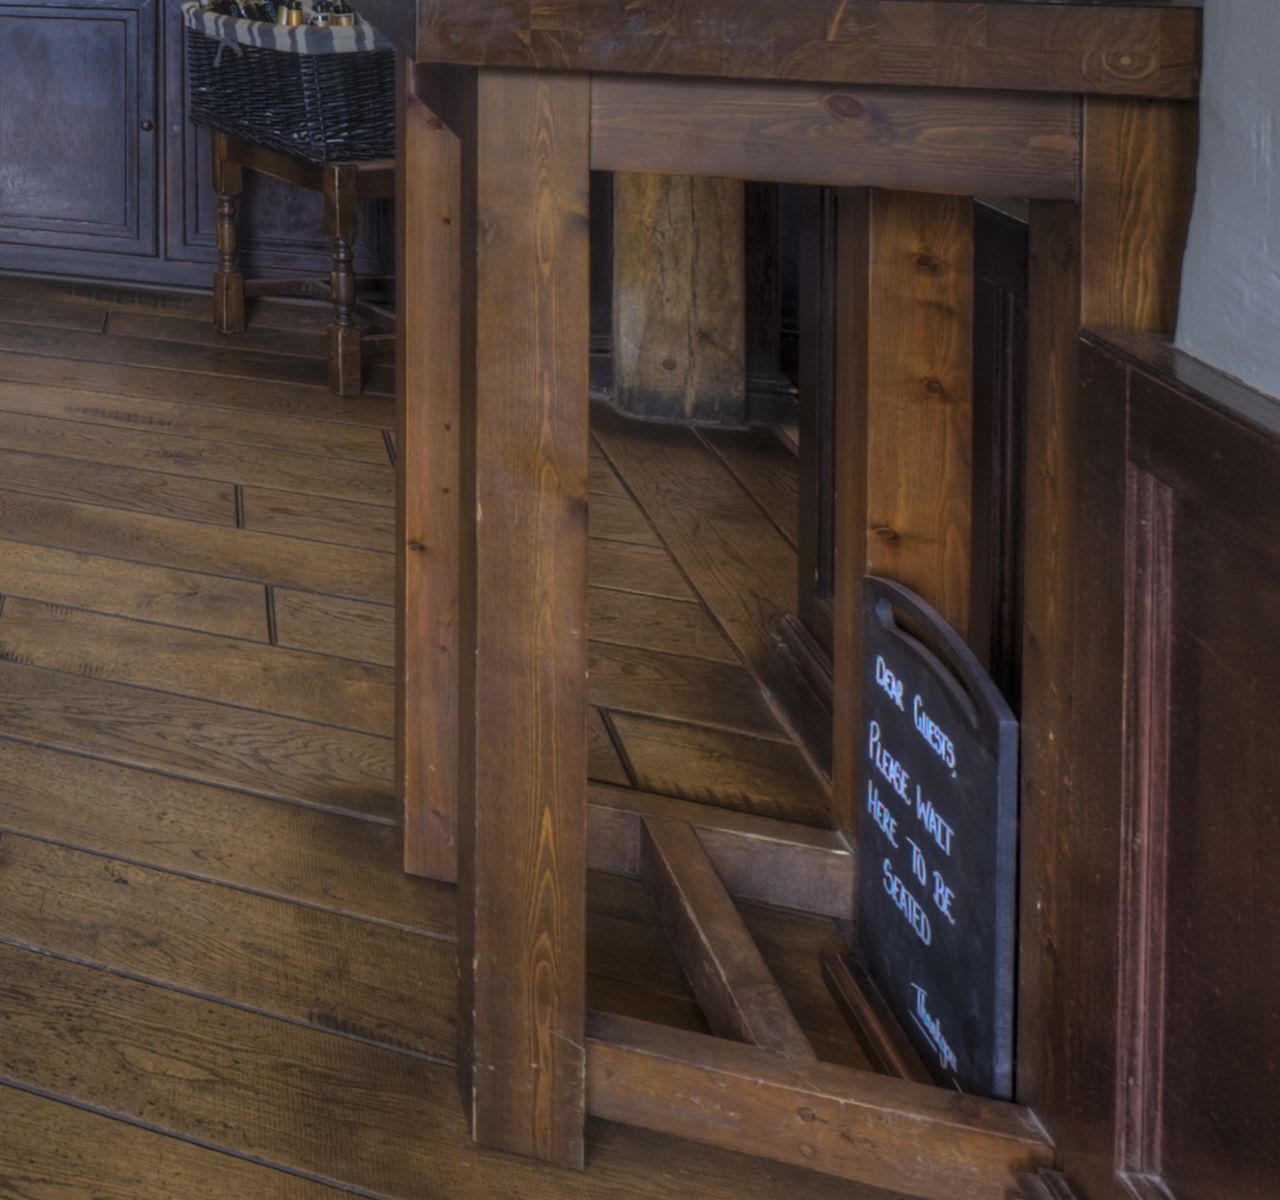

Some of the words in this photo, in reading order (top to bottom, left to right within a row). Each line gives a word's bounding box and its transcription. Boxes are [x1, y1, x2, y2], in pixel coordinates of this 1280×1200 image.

[875, 655, 905, 712] DEAR
[868, 720, 912, 806] PLEASE
[916, 784, 955, 857] WAIT
[867, 779, 900, 849] HERE
[905, 836, 927, 887] TO
[932, 870, 956, 926] BE
[883, 858, 931, 946] SEATED
